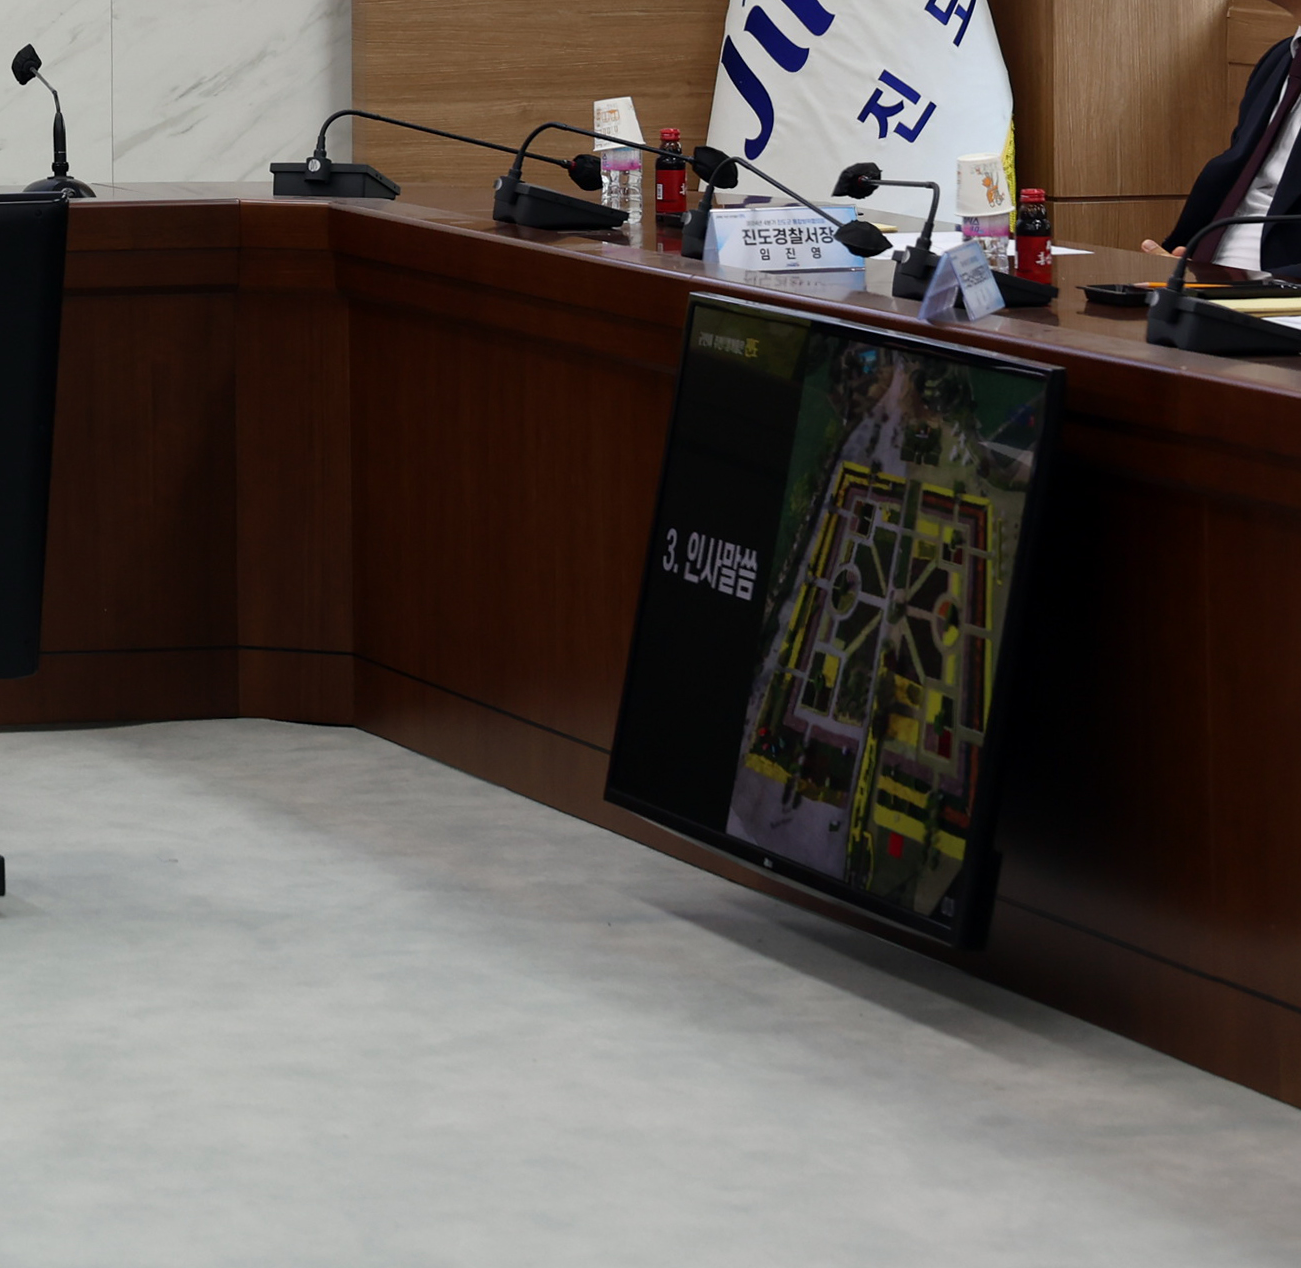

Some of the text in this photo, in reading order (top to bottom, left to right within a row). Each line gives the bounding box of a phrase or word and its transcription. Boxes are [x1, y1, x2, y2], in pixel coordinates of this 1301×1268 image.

[741, 226, 835, 246] 진도경찰서장
[759, 246, 822, 261] 임 진 영
[662, 528, 758, 601] 3. 인사말씀
